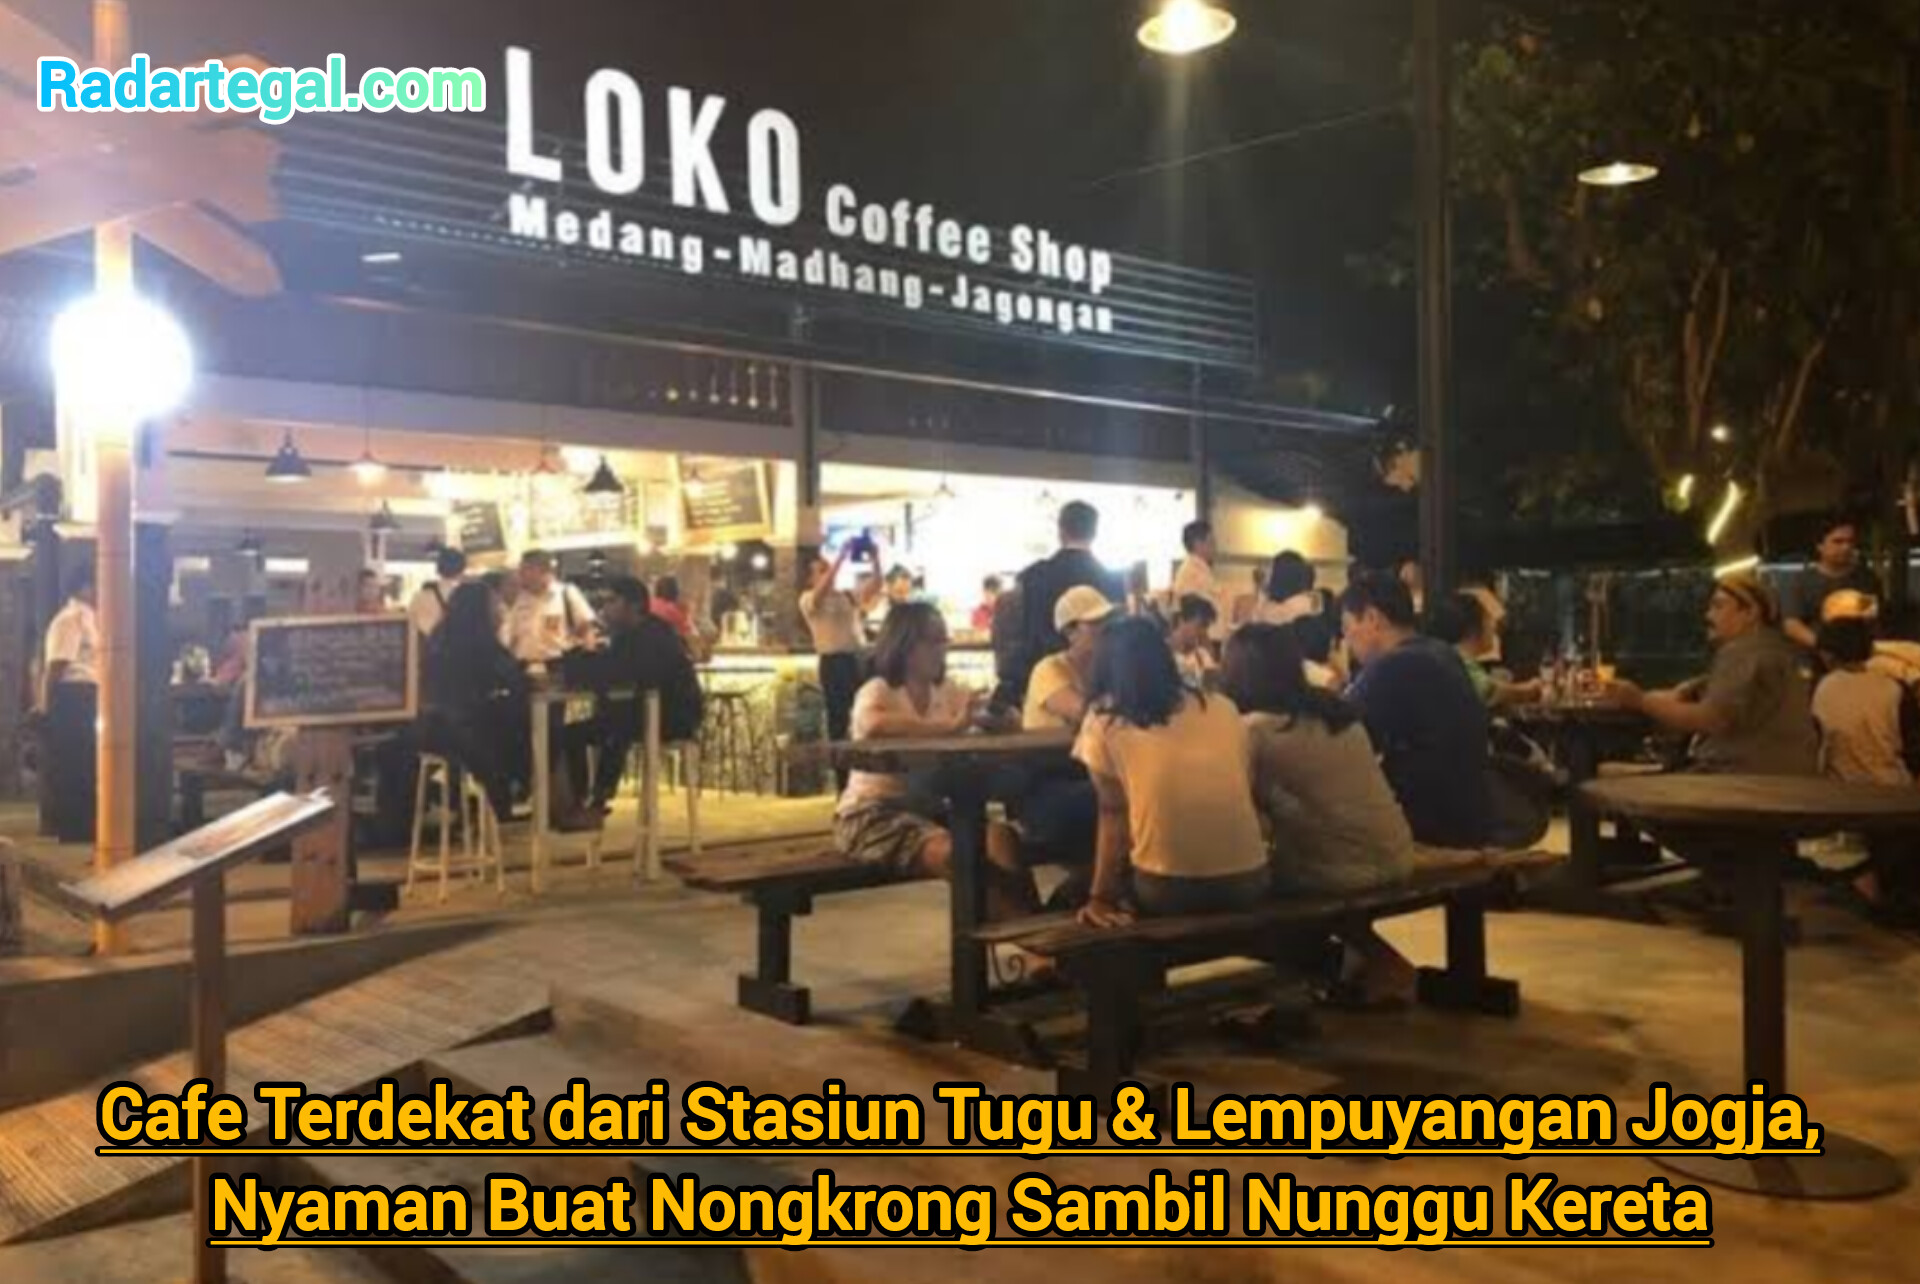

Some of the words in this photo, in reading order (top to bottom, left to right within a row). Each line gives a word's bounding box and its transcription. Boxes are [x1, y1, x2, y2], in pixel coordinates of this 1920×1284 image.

[506, 47, 801, 226] LOKO
[826, 184, 991, 264] Coffee
[1010, 224, 1112, 295] Shop
